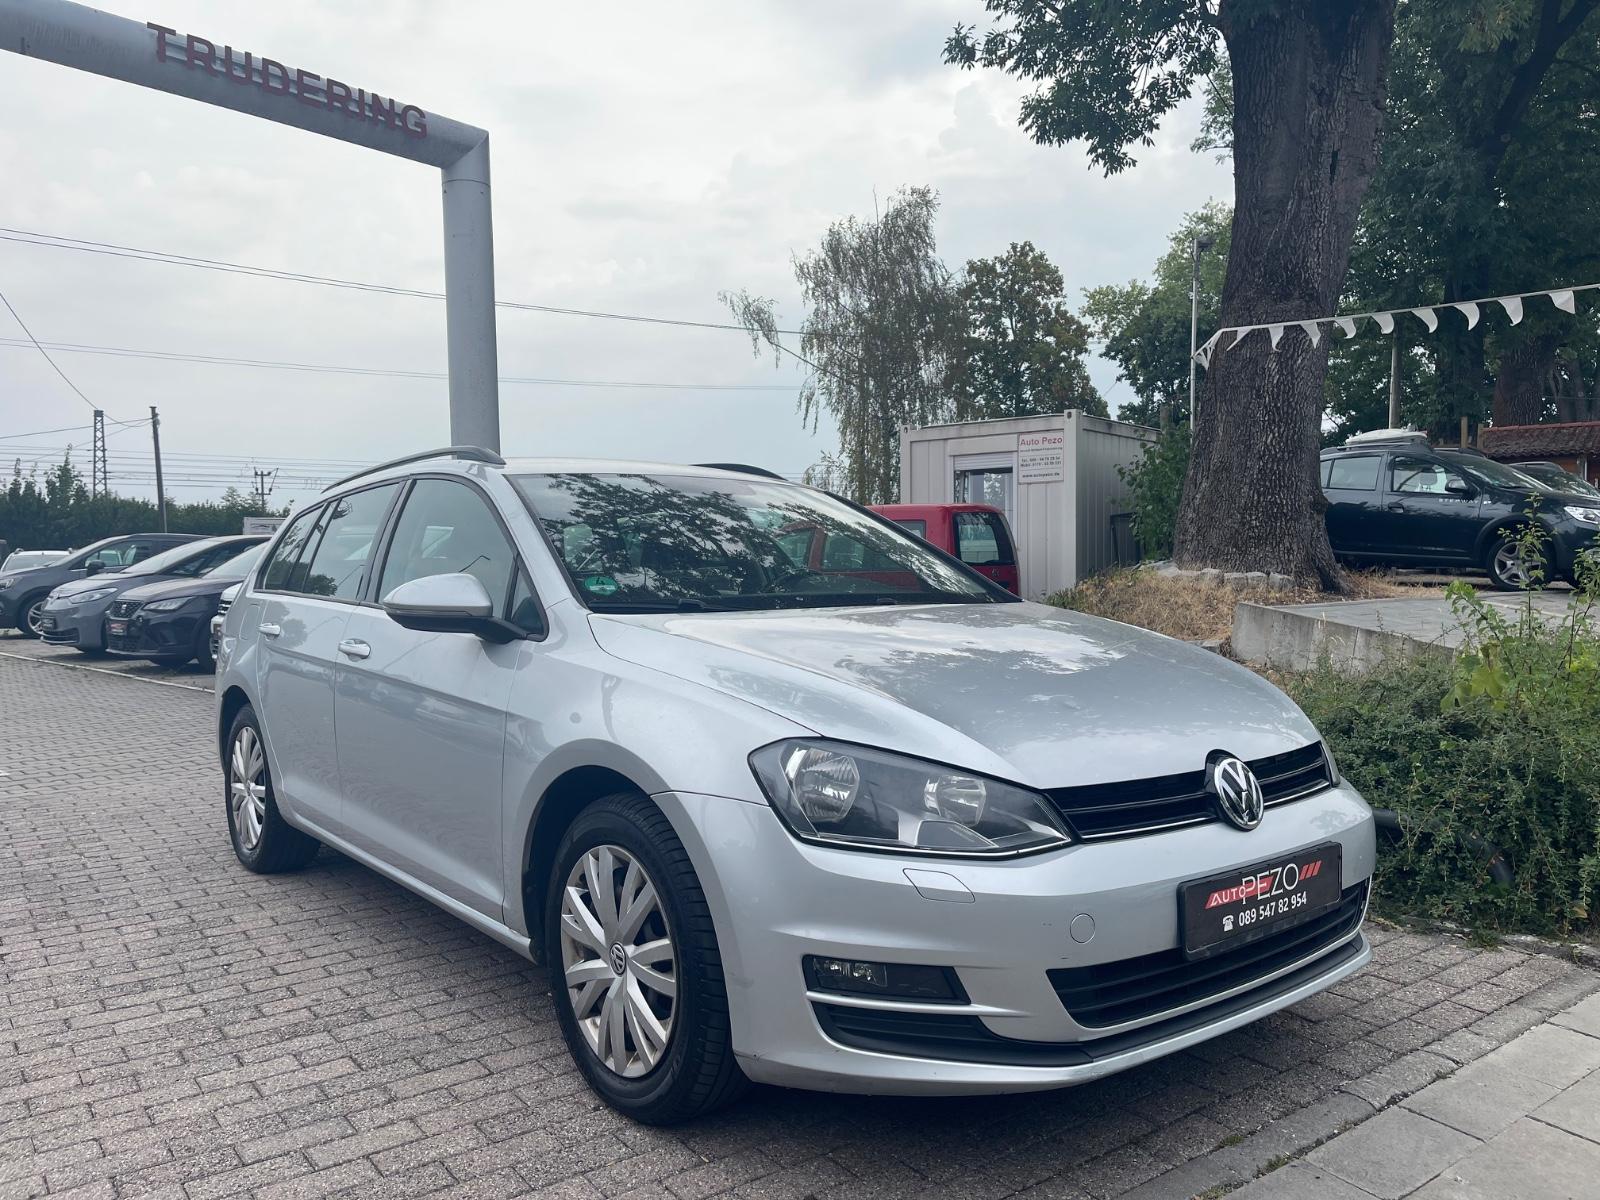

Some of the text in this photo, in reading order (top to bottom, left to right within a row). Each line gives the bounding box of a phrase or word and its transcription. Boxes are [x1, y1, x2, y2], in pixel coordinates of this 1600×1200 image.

[146, 21, 428, 139] TRUDERING
[1042, 437, 1062, 445] Pezo
[1210, 863, 1299, 906] AUTO PEZO
[1238, 891, 1307, 927] 089 547 82 954
